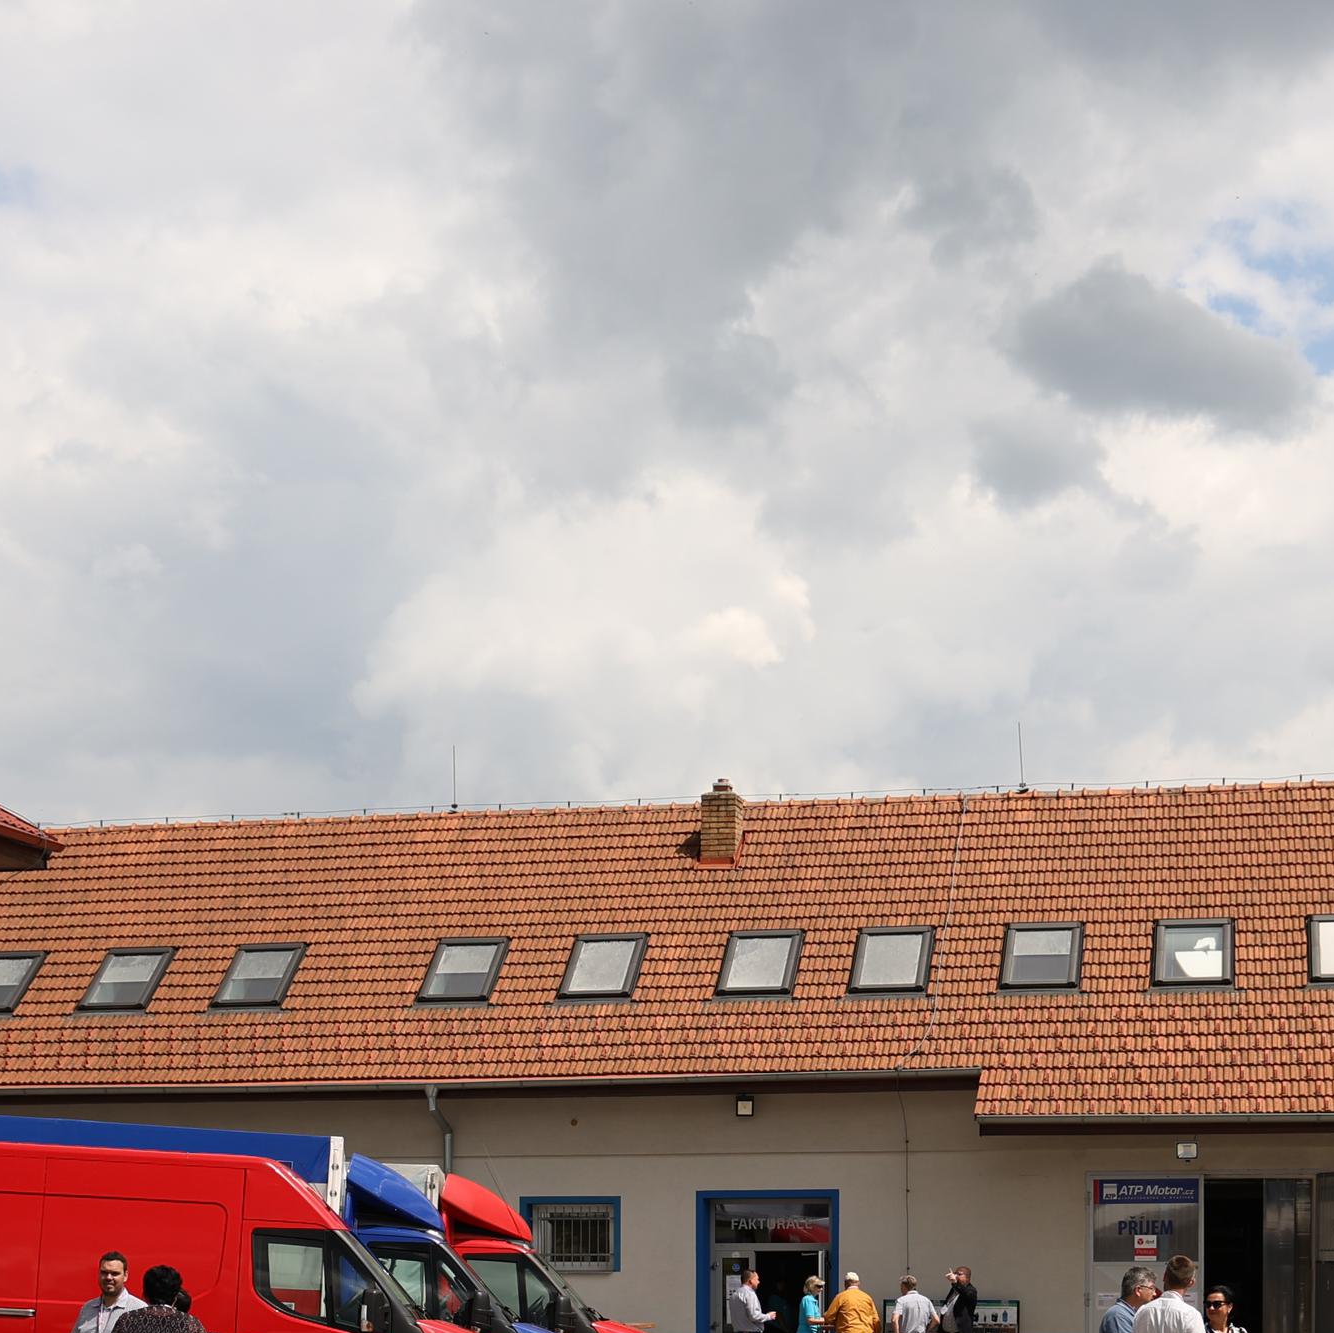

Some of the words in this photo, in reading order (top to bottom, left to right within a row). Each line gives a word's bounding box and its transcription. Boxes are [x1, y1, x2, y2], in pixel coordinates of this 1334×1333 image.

[1118, 1185, 1143, 1195] ATP
[1145, 1185, 1194, 1195] Motor.cz
[1117, 1215, 1174, 1236] PŘÍJEM
